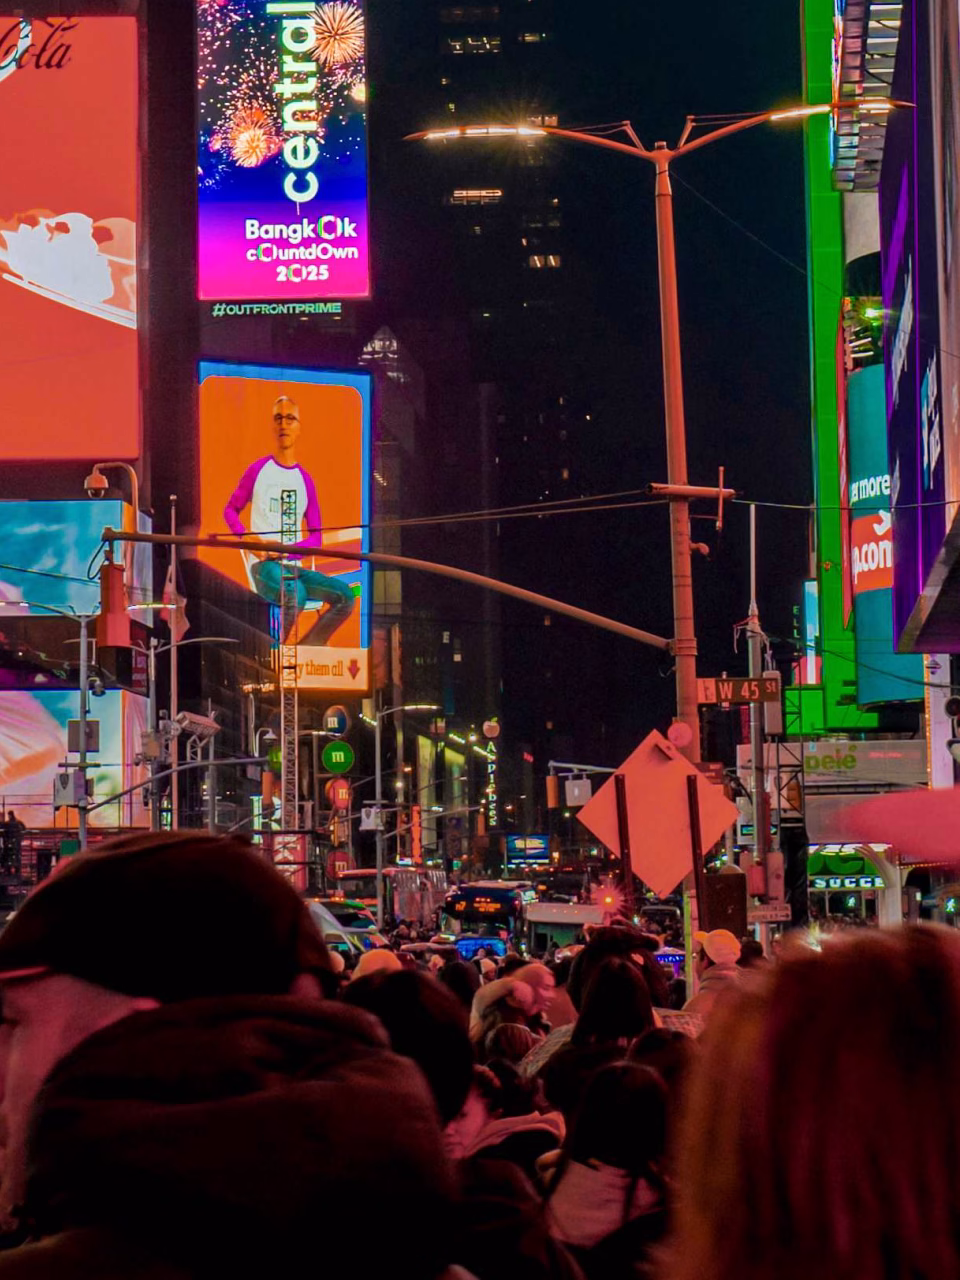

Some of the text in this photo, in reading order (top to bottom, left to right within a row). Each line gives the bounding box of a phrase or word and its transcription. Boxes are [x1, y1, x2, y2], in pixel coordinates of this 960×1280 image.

[276, 264, 330, 282] 2025
[212, 302, 342, 317] #OUTFRONTPRIME
[860, 474, 890, 500] more
[306, 660, 330, 677] them
[332, 660, 343, 677] all
[719, 682, 733, 699] W
[741, 681, 759, 699] 45
[332, 751, 345, 763] m
